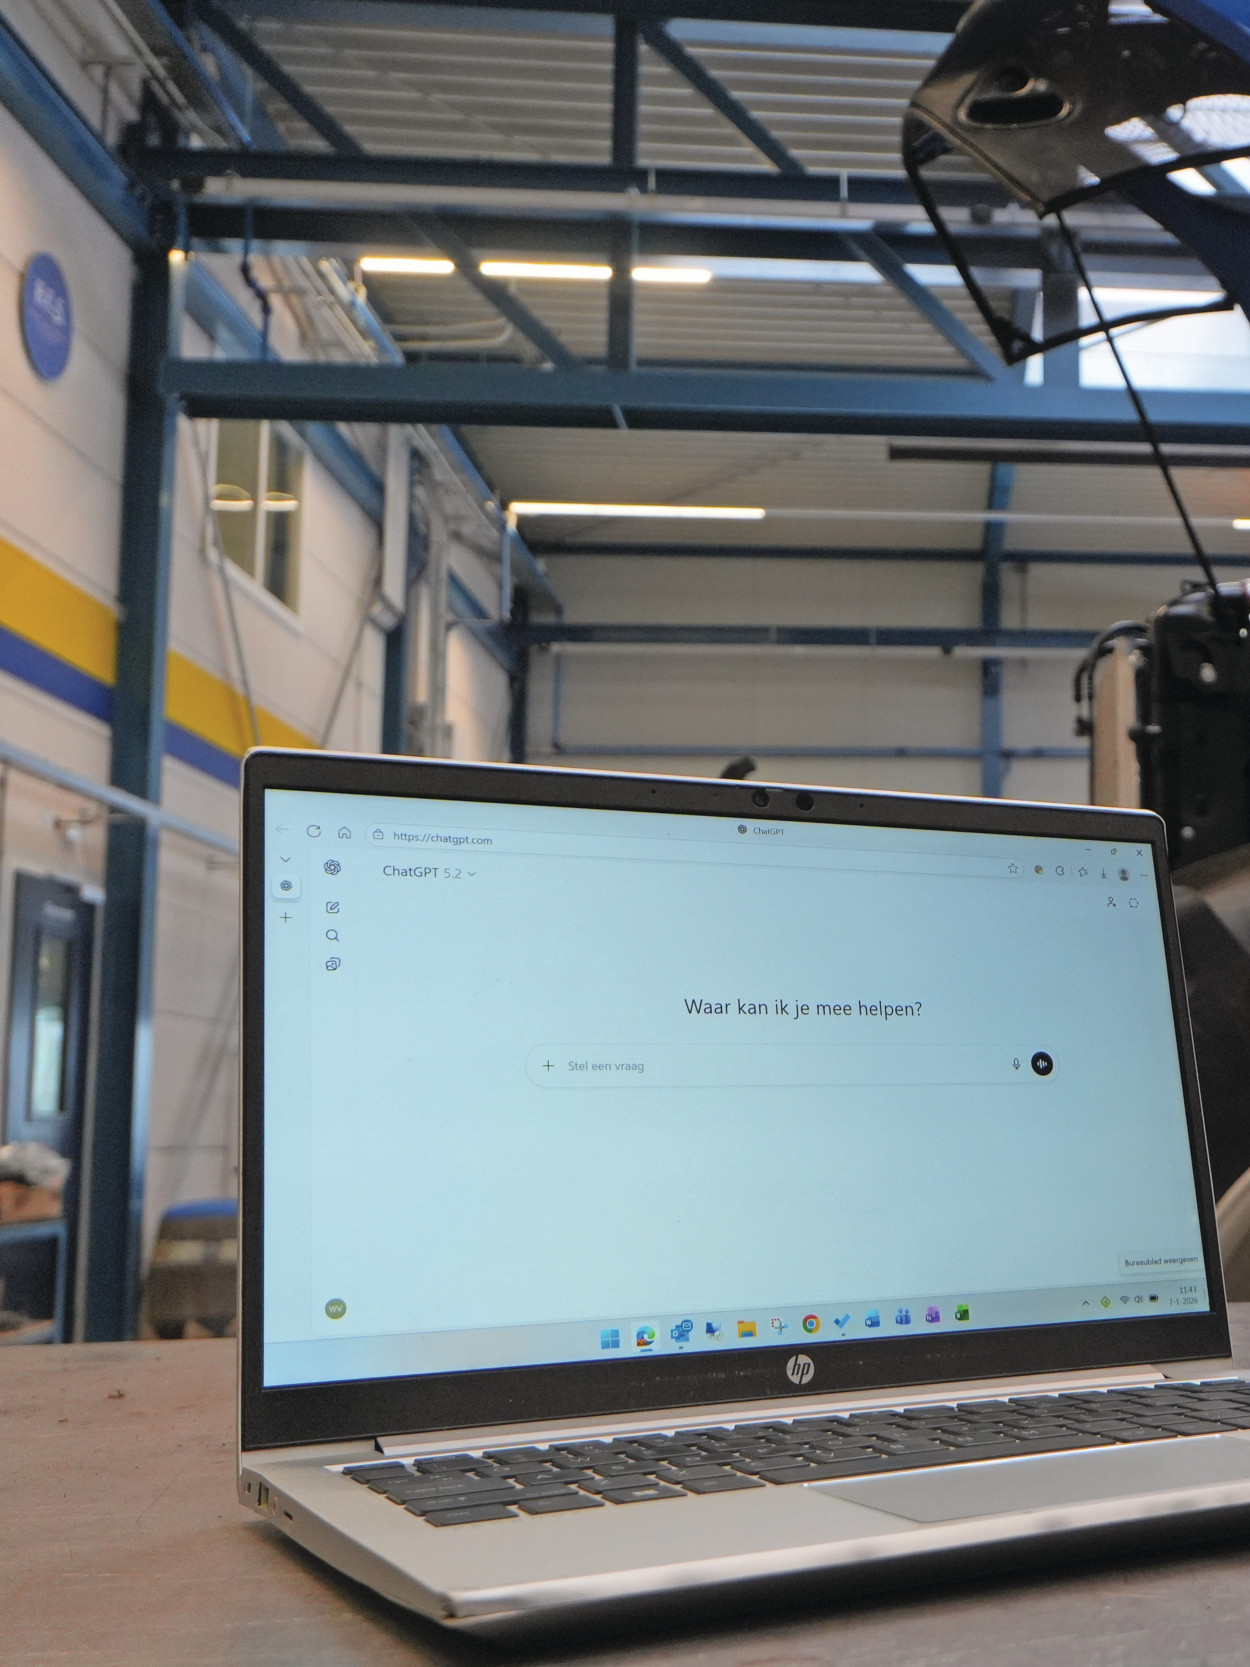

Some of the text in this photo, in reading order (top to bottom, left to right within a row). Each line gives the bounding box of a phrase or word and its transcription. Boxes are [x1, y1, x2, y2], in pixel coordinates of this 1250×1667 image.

[393, 831, 493, 846] https://chatgpt.com
[753, 827, 784, 836] ChatGPT
[382, 865, 462, 880] ChatGPT 5.2
[684, 998, 922, 1020] Waar kan ik je mee helpen?
[568, 1060, 645, 1074] Stel een vraag
[1125, 1256, 1199, 1267] Bureaublad weergeven
[1180, 1286, 1197, 1294] 11:43
